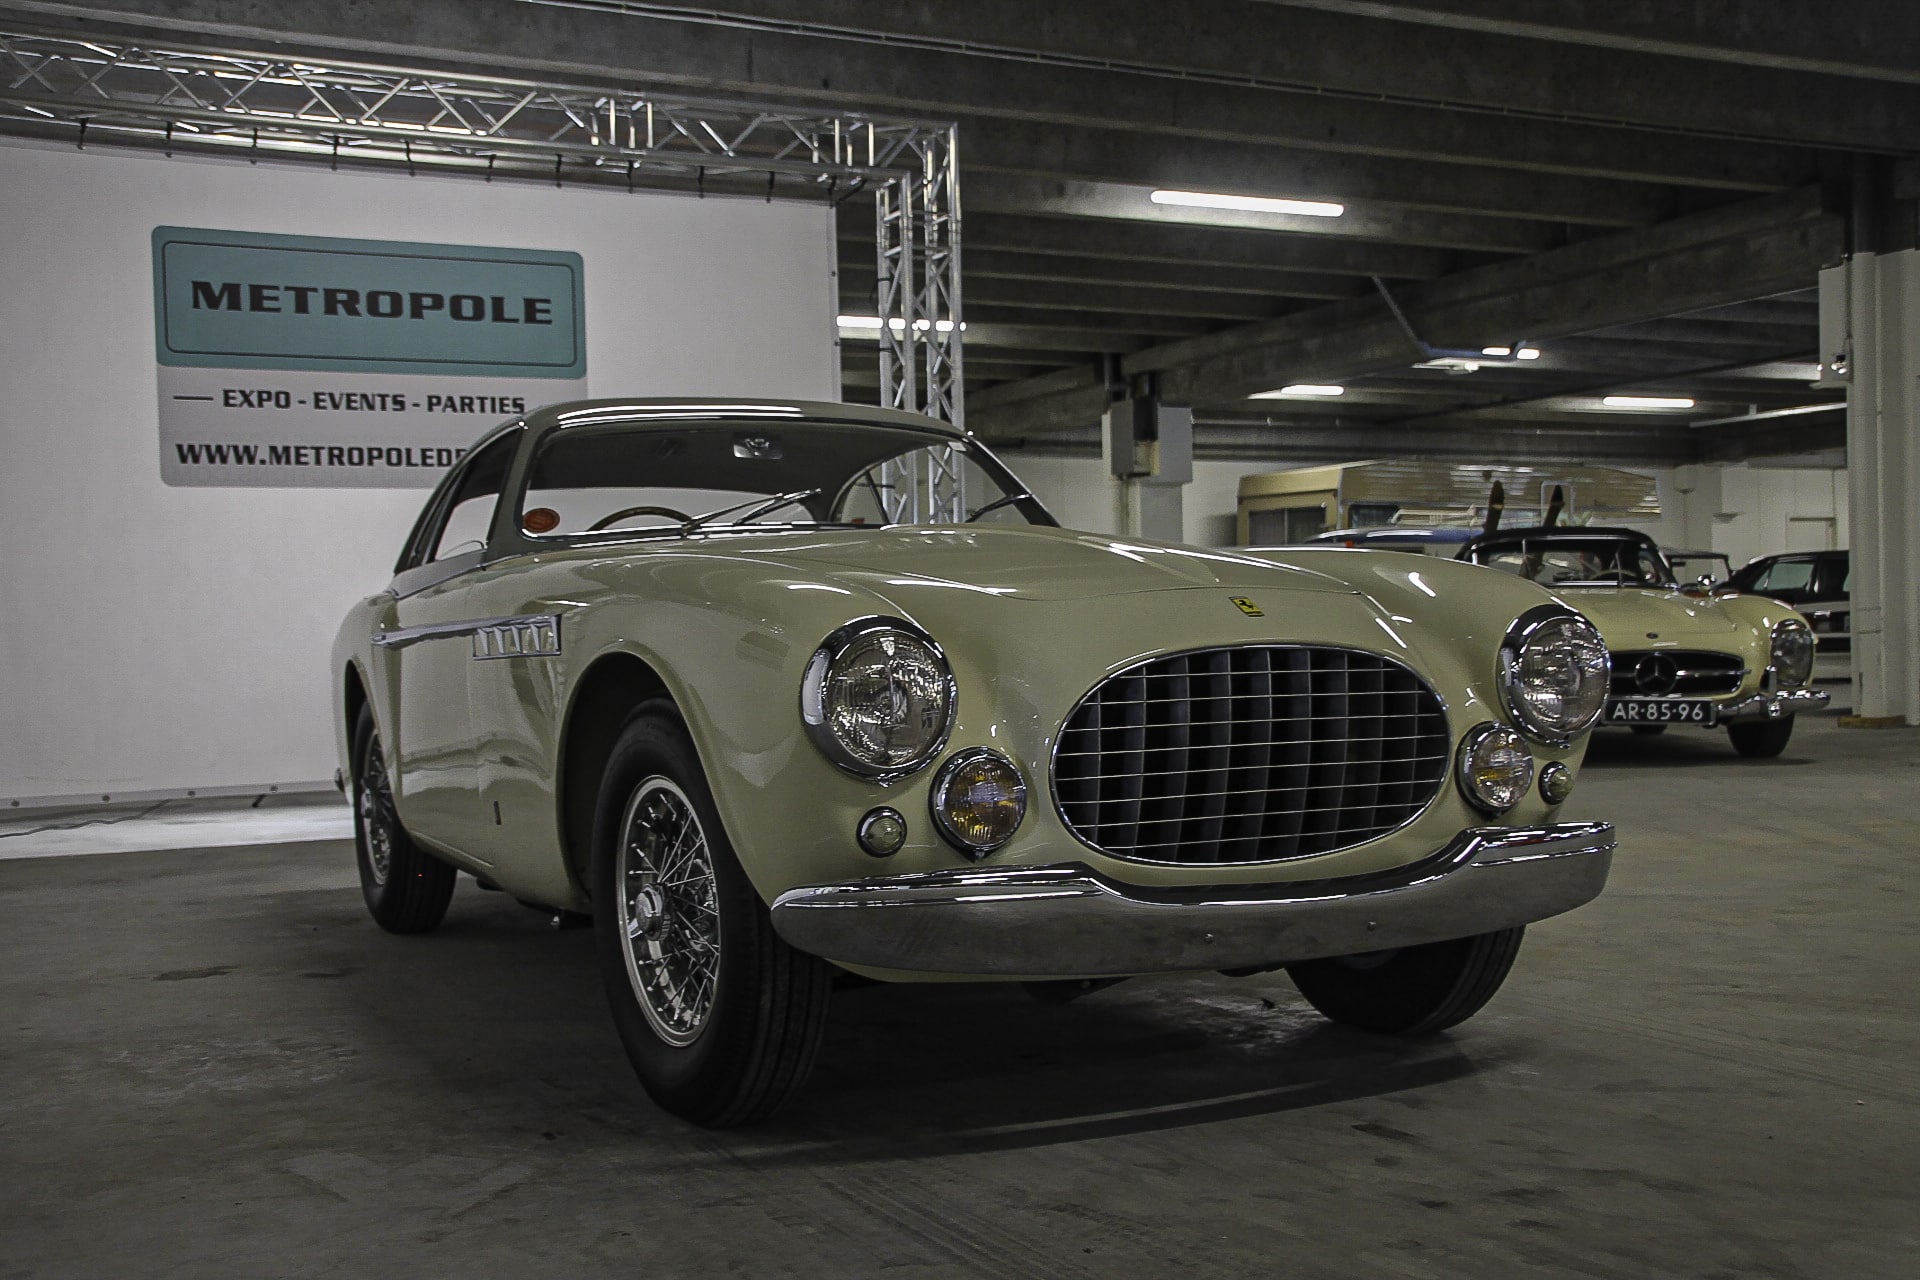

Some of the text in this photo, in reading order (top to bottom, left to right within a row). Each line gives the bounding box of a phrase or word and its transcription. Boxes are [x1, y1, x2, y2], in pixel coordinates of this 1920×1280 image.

[191, 280, 553, 325] METROPOLE
[222, 389, 526, 415] EXPO EVENTS PARTIES
